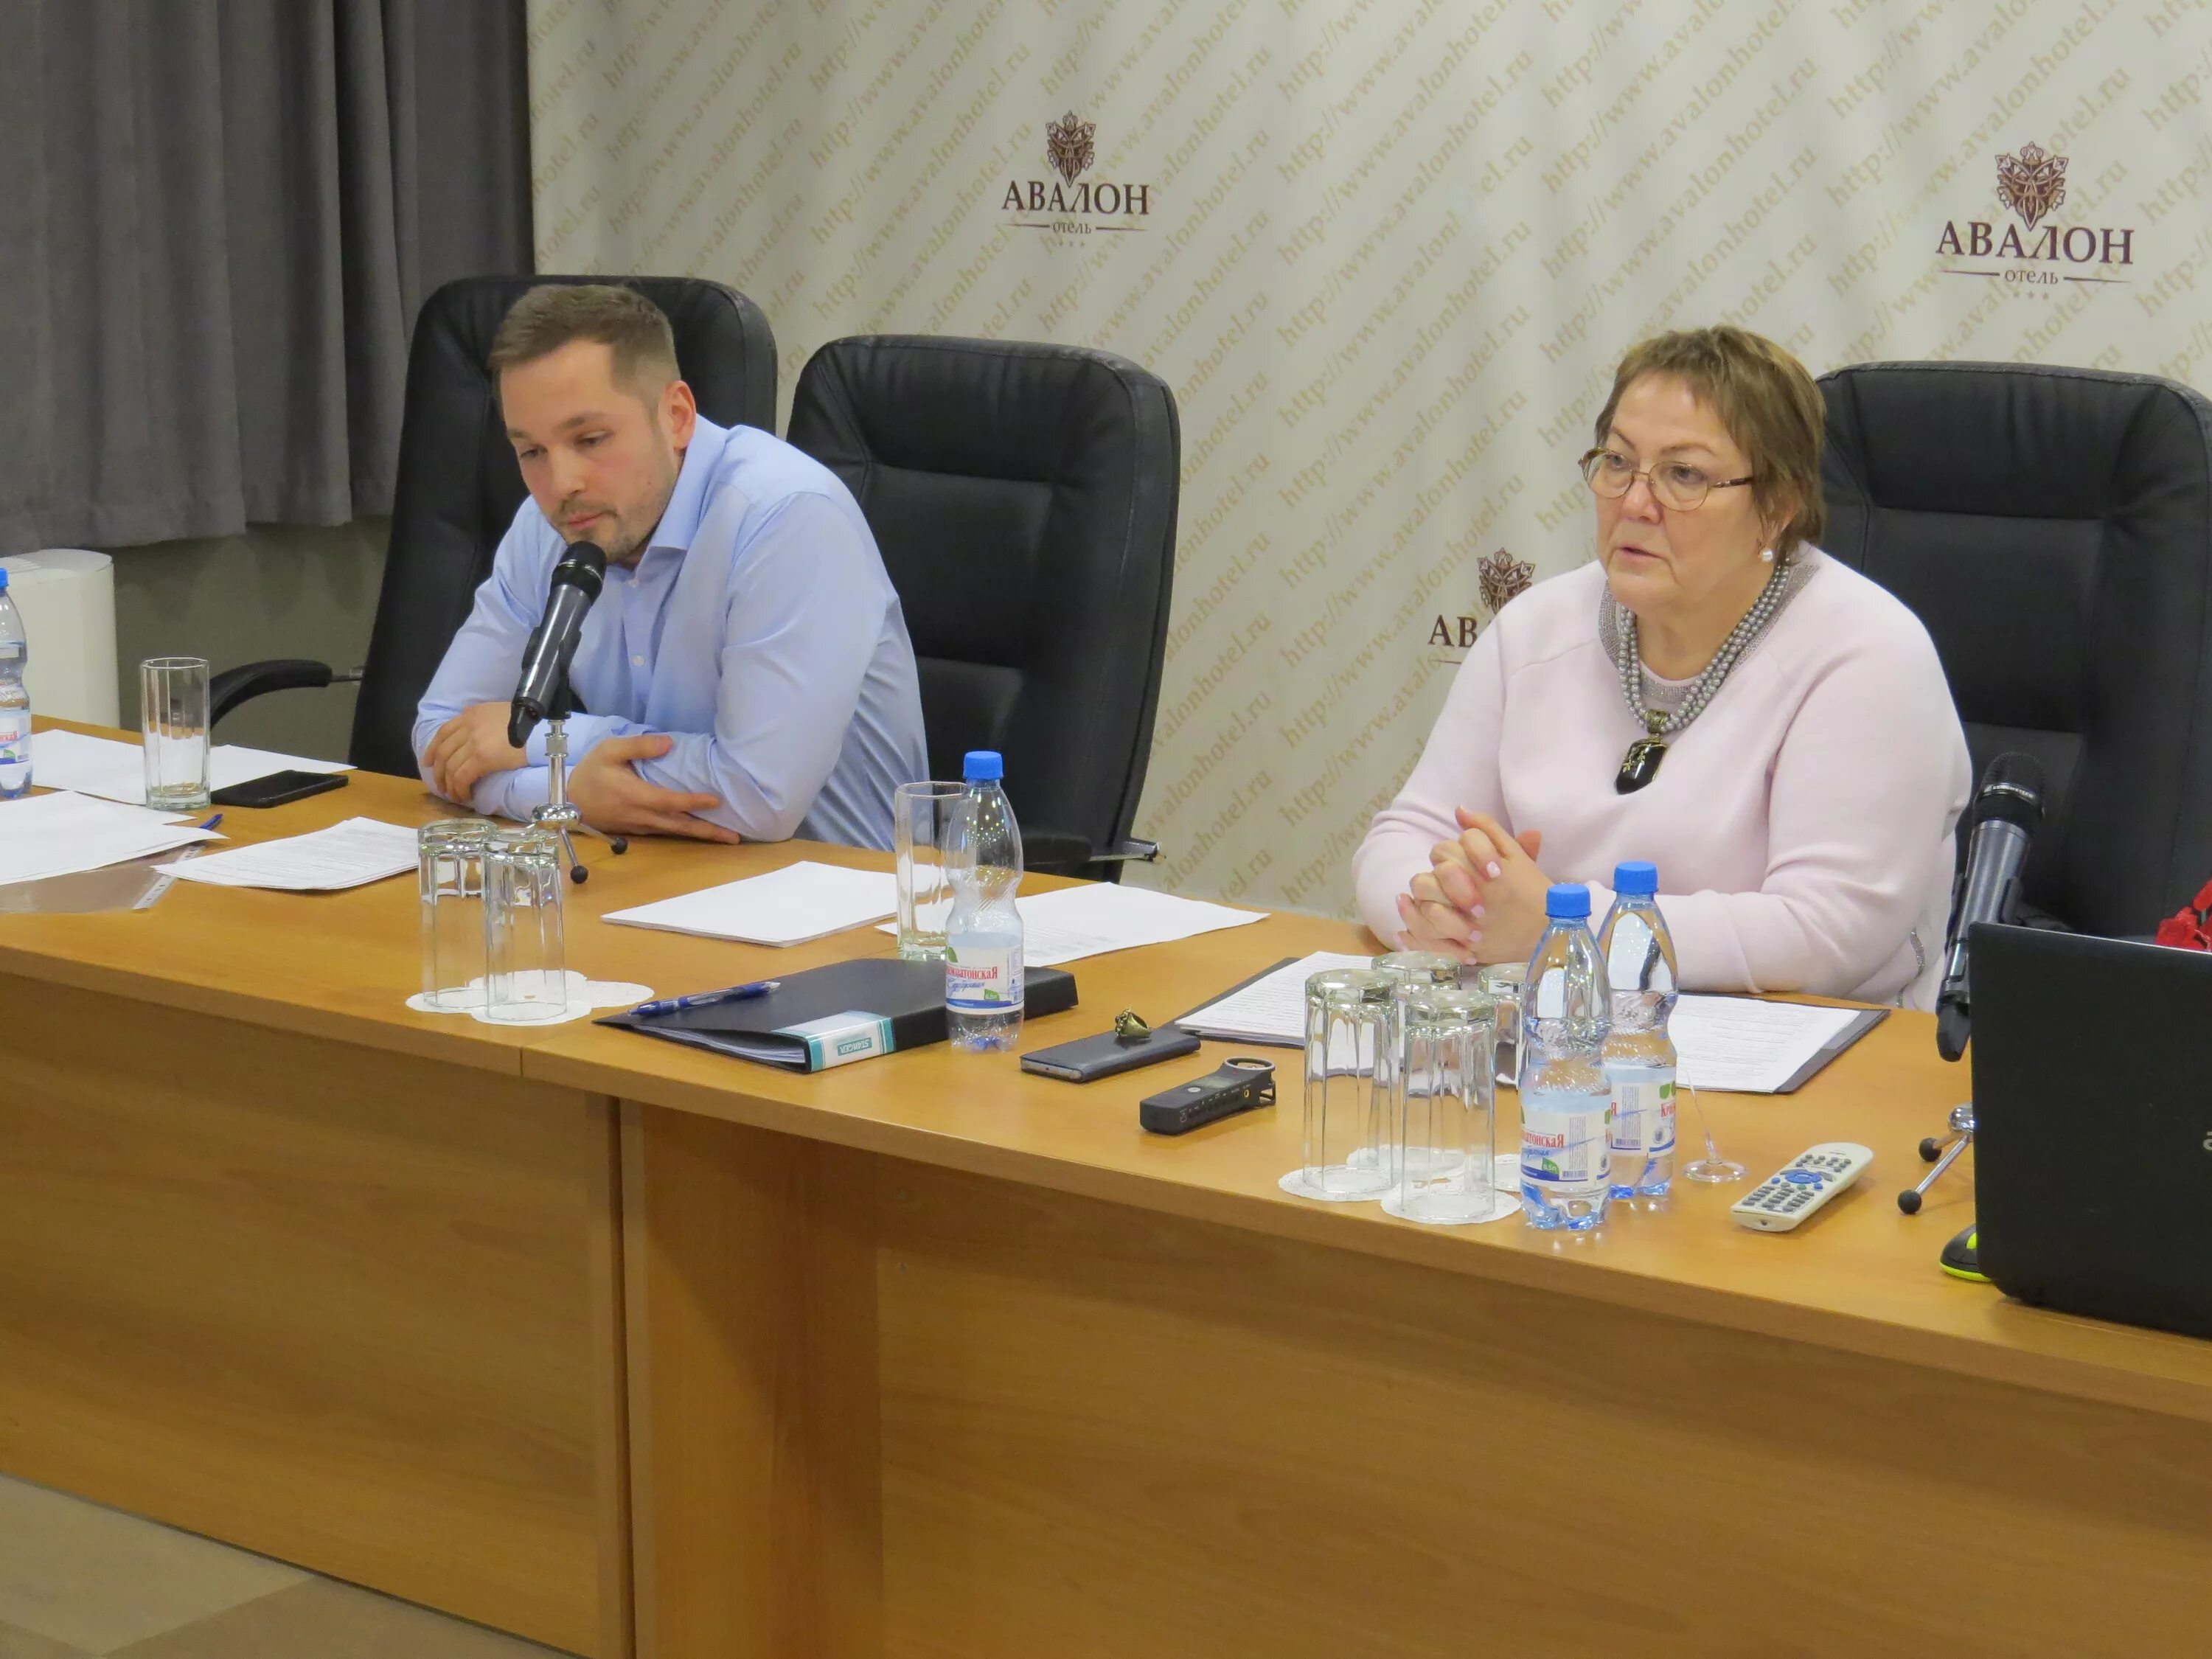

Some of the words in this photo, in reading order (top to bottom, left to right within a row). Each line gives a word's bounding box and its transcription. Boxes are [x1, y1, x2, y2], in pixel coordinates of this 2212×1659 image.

[812, 41, 1032, 321] http://www.avalonhotel.ru
[1001, 179, 1150, 215] АВАЛОН
[1052, 220, 1092, 235] отель
[1276, 49, 1534, 348] http://www.avalonhotel.ru
[1538, 55, 1818, 364] http://www.avalonhotel.ru
[1935, 220, 2135, 265] АВАЛОН
[2004, 268, 2059, 285] отель
[1277, 220, 1532, 509] http://www.avalonhotel.ru
[1278, 305, 1532, 590] http://www.avalonhotel.ru
[1278, 473, 1526, 749] http://www.avalonhotel.ru
[1279, 389, 1529, 668] http://www.avalonhotel.ru
